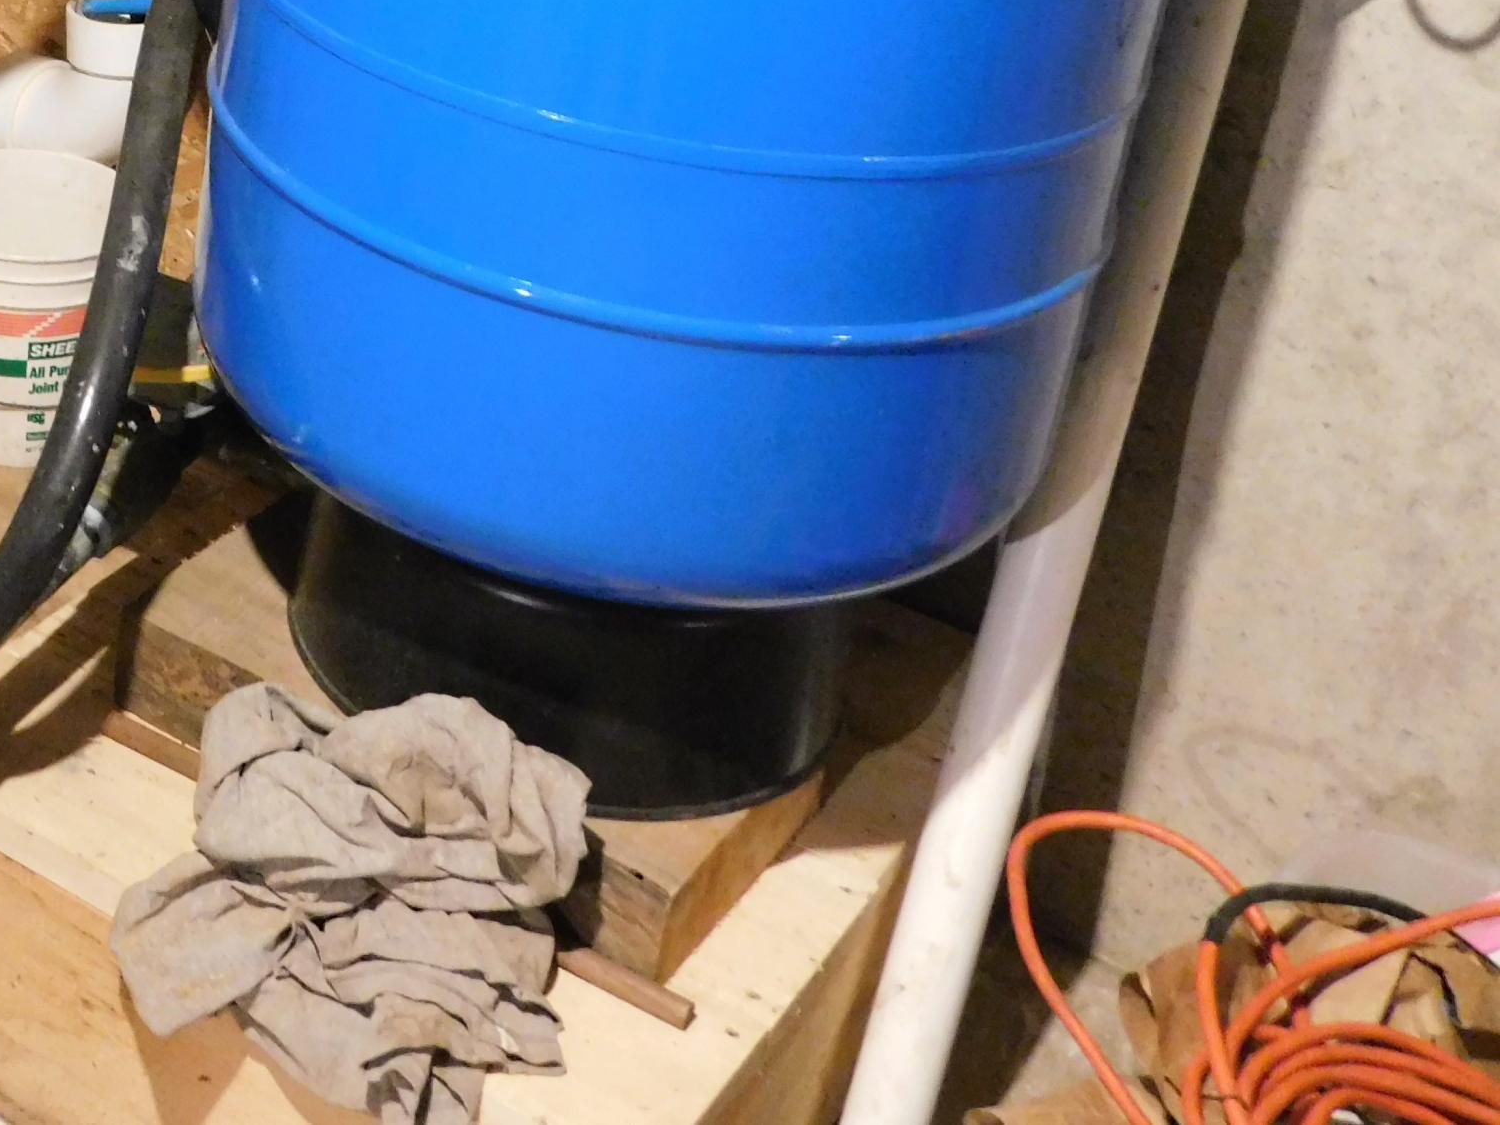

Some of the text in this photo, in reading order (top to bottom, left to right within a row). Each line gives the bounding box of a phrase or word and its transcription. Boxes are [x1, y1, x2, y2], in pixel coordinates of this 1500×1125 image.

[31, 341, 76, 357] SHEE
[30, 367, 45, 378] All
[28, 381, 59, 394] Joint
